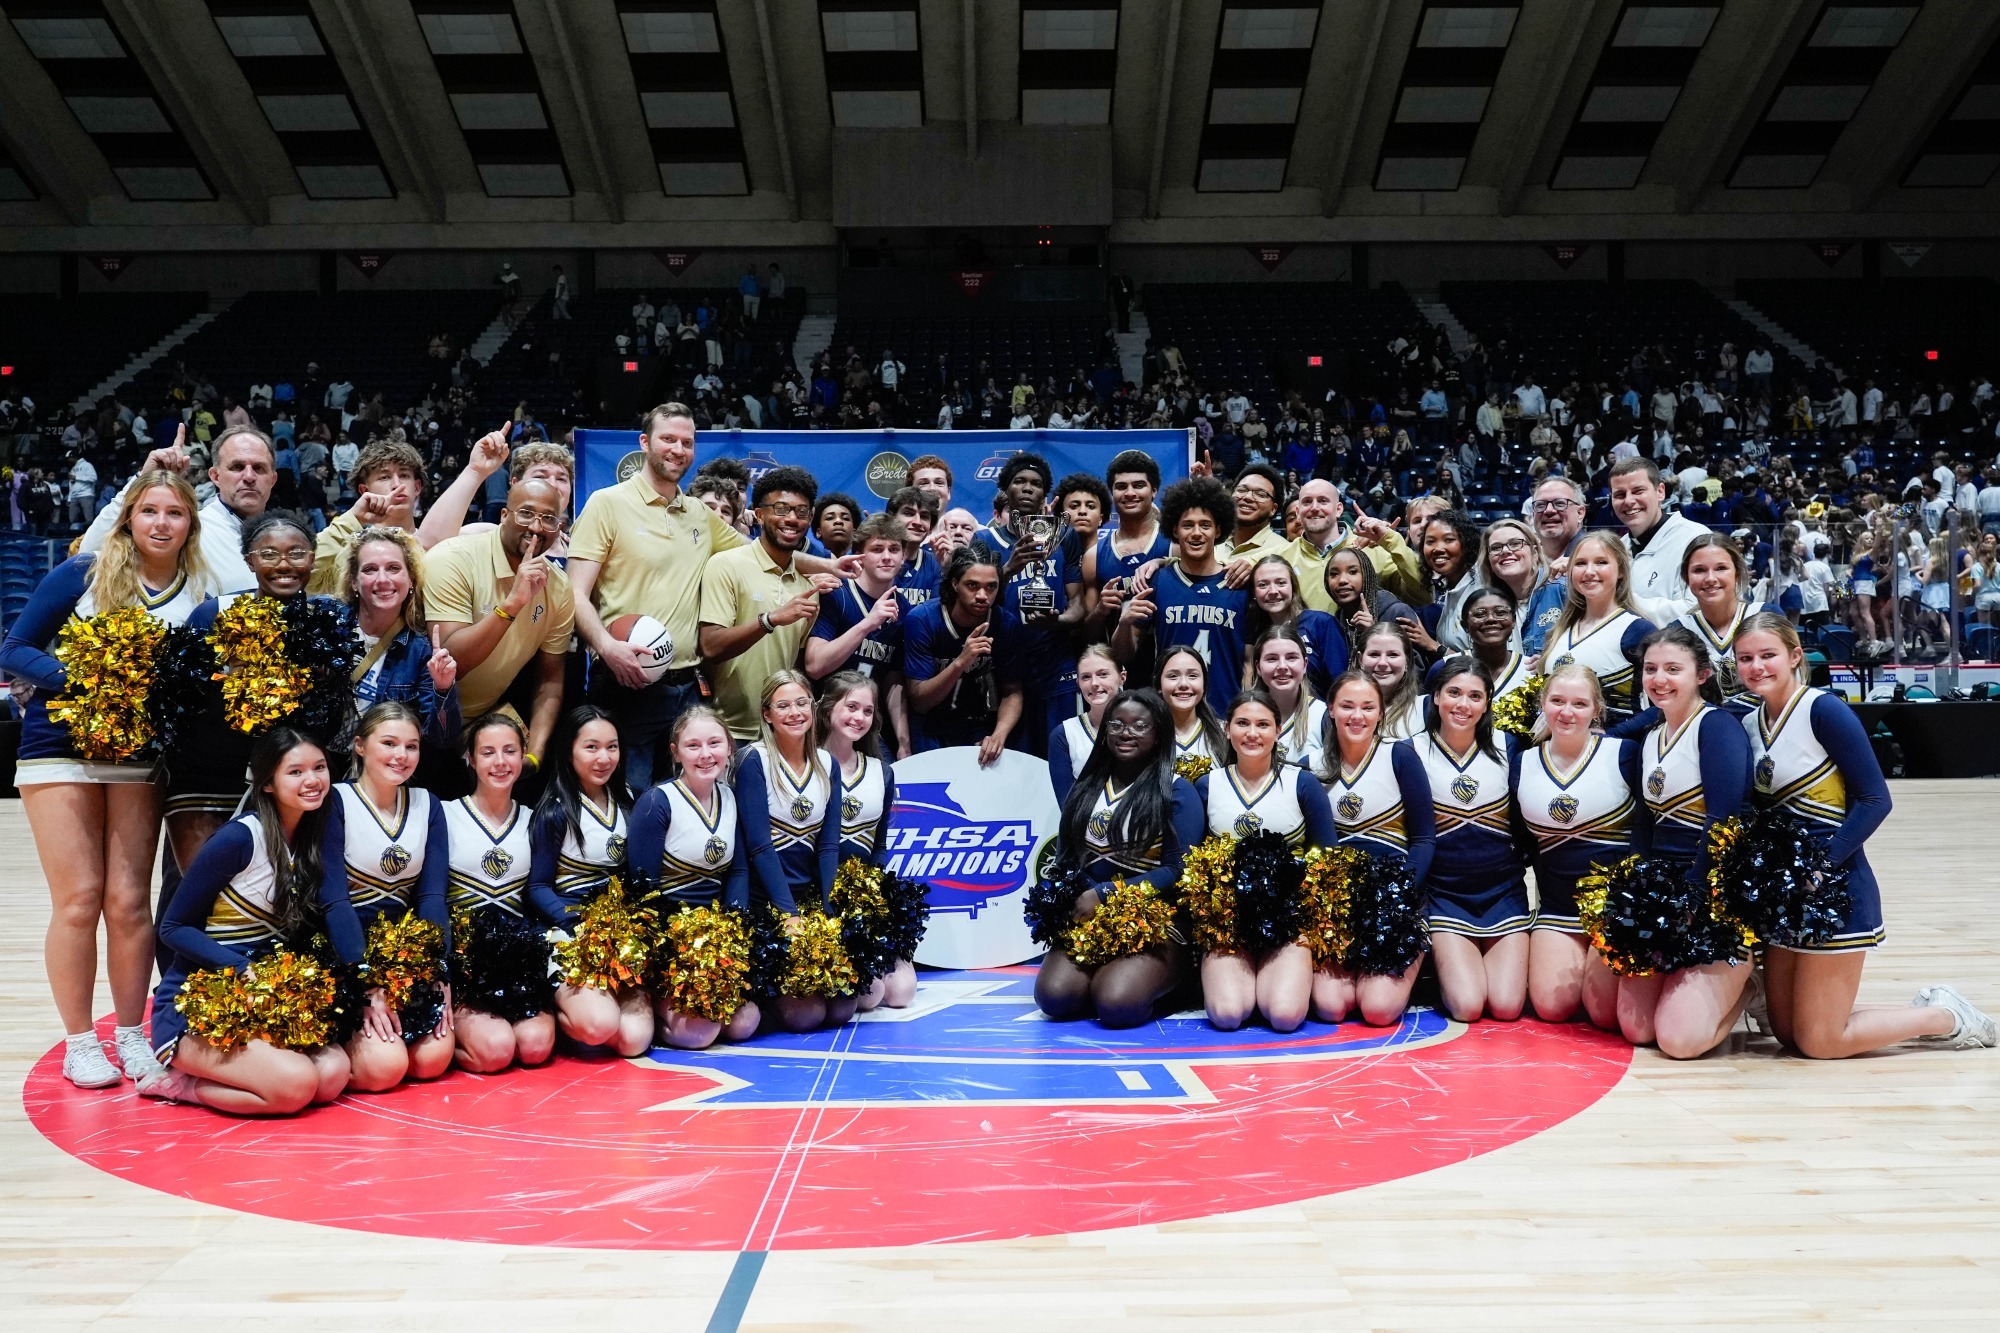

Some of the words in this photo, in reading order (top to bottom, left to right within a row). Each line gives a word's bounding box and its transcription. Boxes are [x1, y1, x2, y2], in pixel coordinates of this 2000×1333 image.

[869, 466, 908, 480] Breda
[1223, 608, 1237, 630] X
[1192, 629, 1212, 671] 4
[884, 849, 1024, 877] AMPIONS
